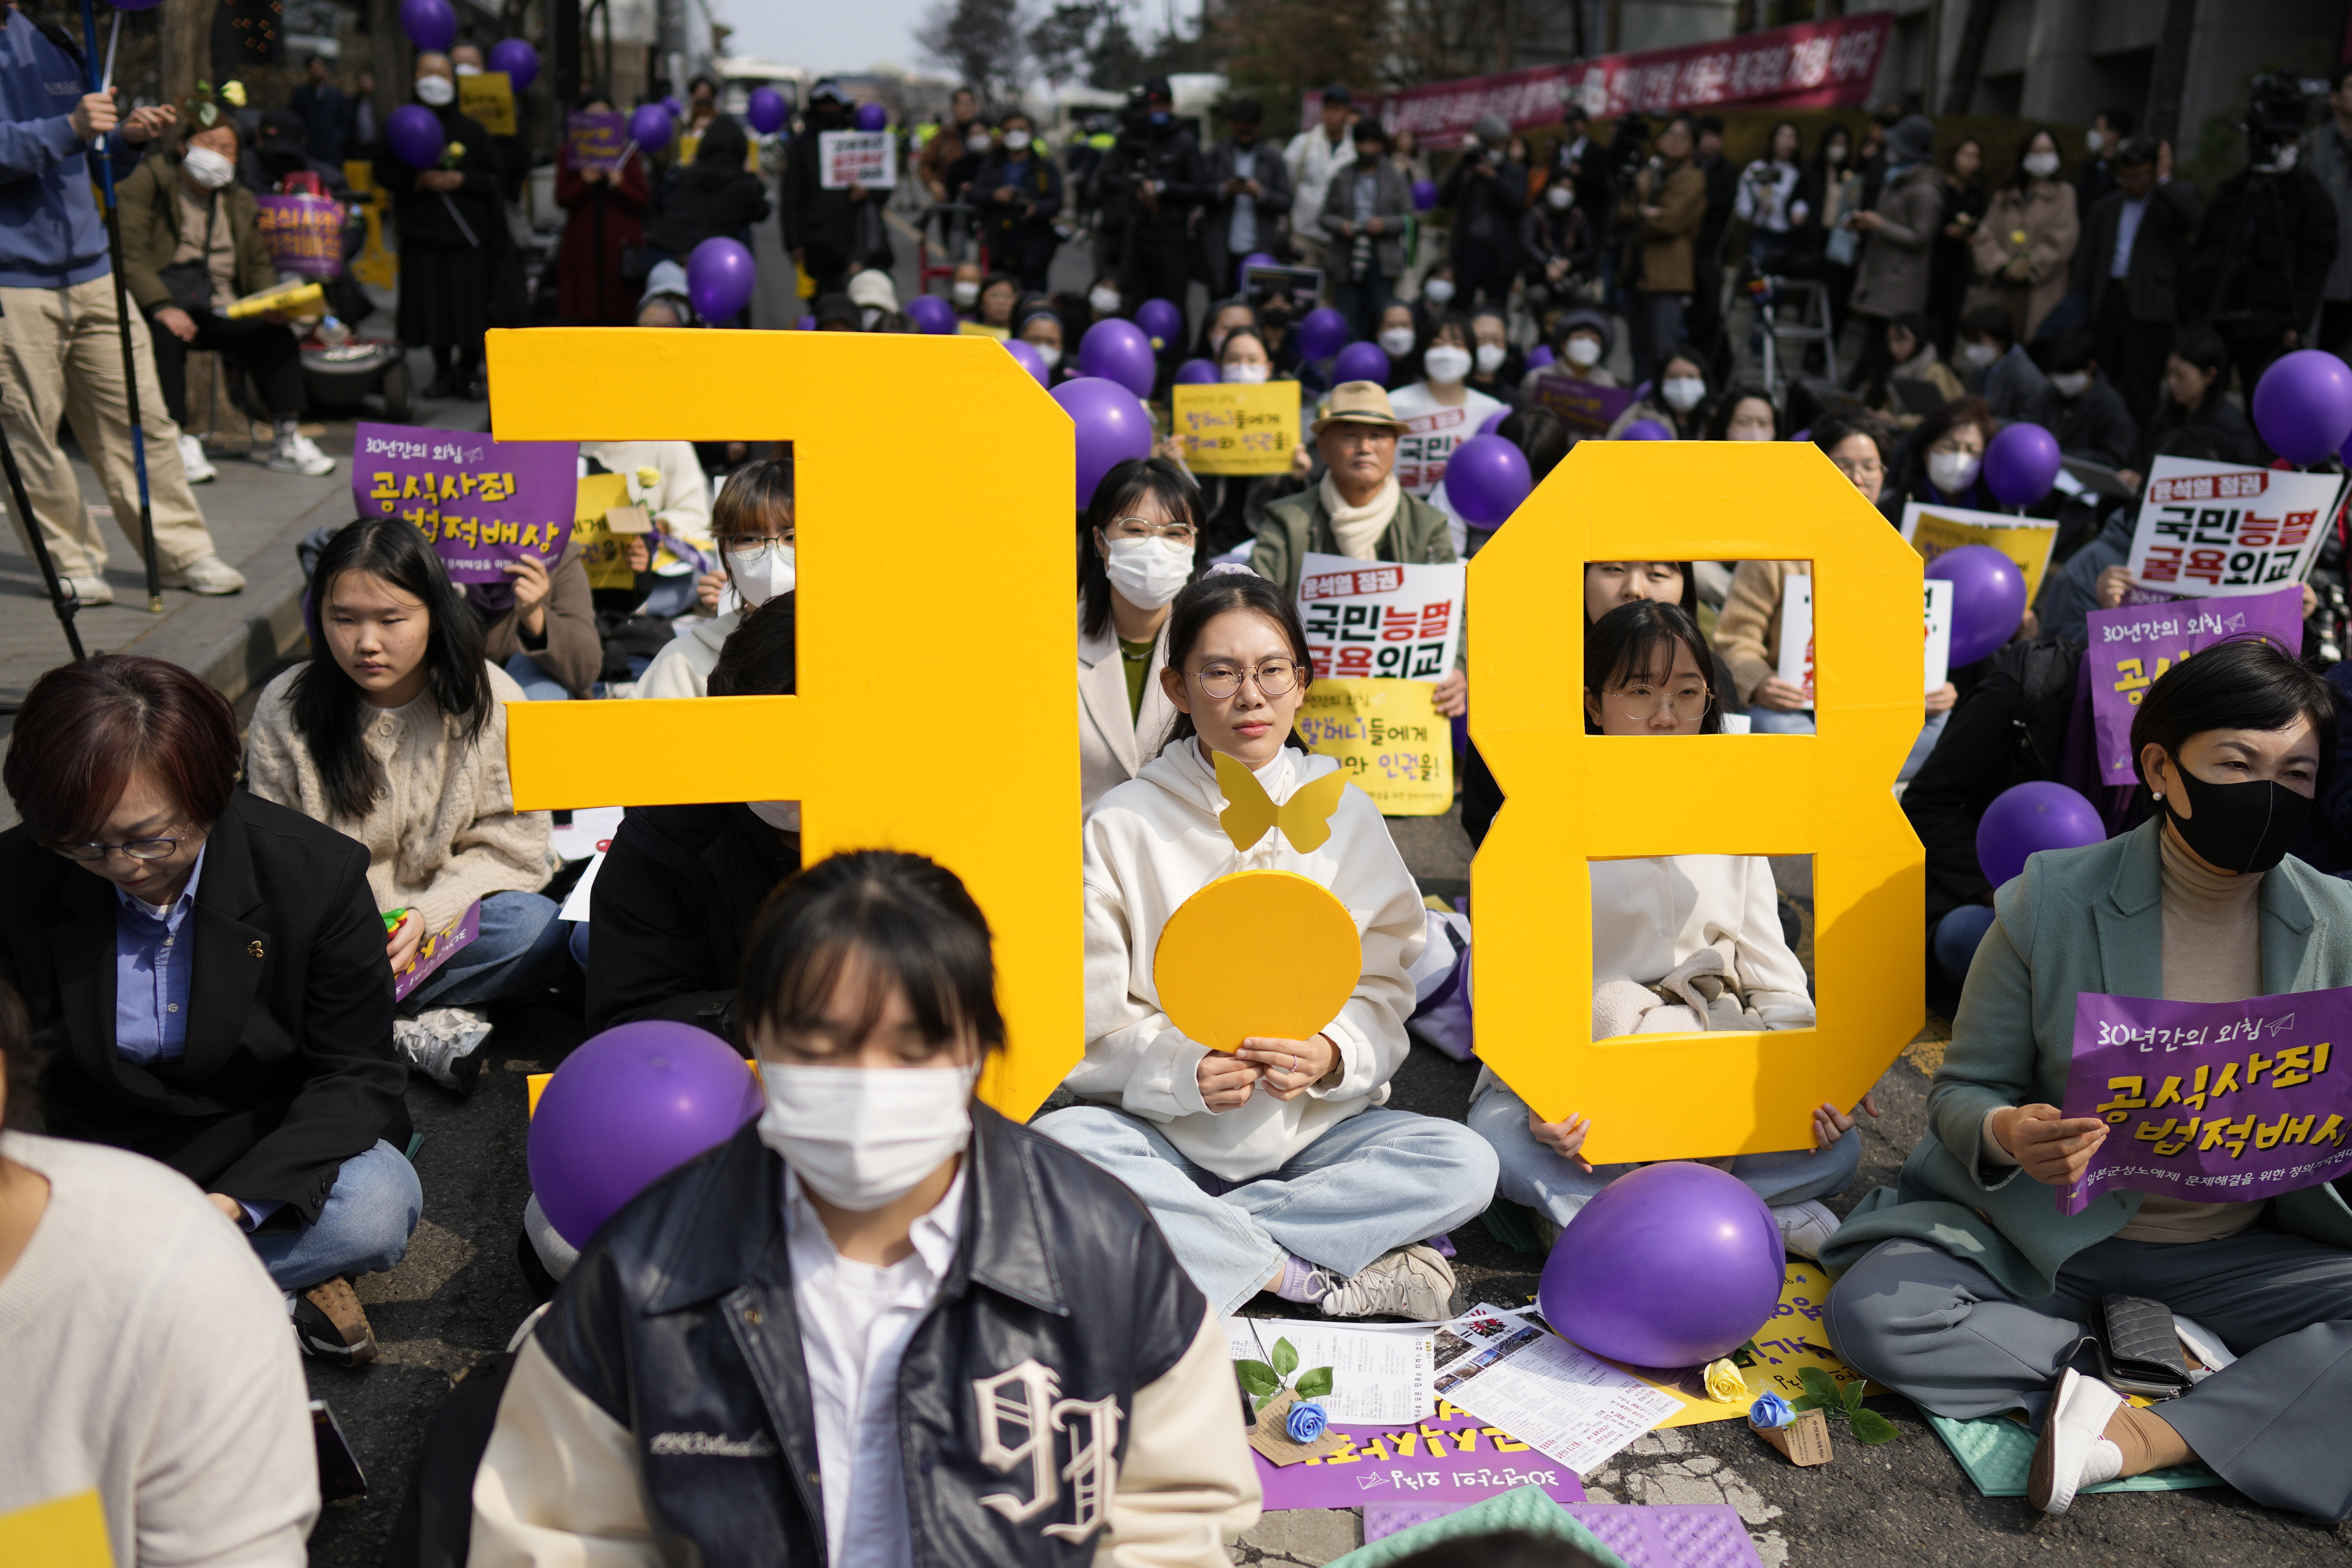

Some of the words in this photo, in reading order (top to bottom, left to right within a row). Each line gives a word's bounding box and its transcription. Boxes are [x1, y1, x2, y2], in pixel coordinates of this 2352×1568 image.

[365, 437, 426, 459] 30년간의
[432, 445, 463, 464] 외침
[370, 471, 515, 513] 공식사죄
[2155, 477, 2213, 501] 윤석열
[2218, 474, 2261, 496] 정권
[403, 507, 560, 553] 법적배상
[2155, 506, 2319, 546] 국민능멸
[2141, 545, 2301, 585] 굴욕외교
[1302, 574, 1354, 599] 윤석열
[1357, 568, 1399, 593] 정권
[1307, 599, 1452, 642] 국민능멸
[2103, 620, 2179, 644] 30년간의
[2187, 612, 2223, 635] 외침
[1307, 641, 1445, 678] 굴욕외교
[1347, 692, 1369, 707] 외침
[1301, 717, 1427, 746] 할머니들에게
[1379, 753, 1439, 781] 인권을!
[409, 927, 467, 988] 30년간의
[2097, 1020, 2209, 1052] 30년간의
[2215, 1018, 2264, 1044] 외침
[2096, 1042, 2331, 1124] 공식사죄
[2134, 1113, 2352, 1158] 법적배상
[2087, 1165, 2181, 1187] 일본군성노예제
[2185, 1172, 2255, 1187] 문제해결을
[2259, 1168, 2285, 1182] 위한
[1489, 1334, 1504, 1343] 일왕과
[1501, 1326, 1517, 1335] 전범기
[1451, 1353, 1472, 1365] 야스쿠니
[1414, 1392, 1422, 1401] 잊은
[1413, 1406, 1422, 1418] 역사를
[1390, 1470, 1440, 1491] 외침
[1452, 1468, 1560, 1488] 30년간의
